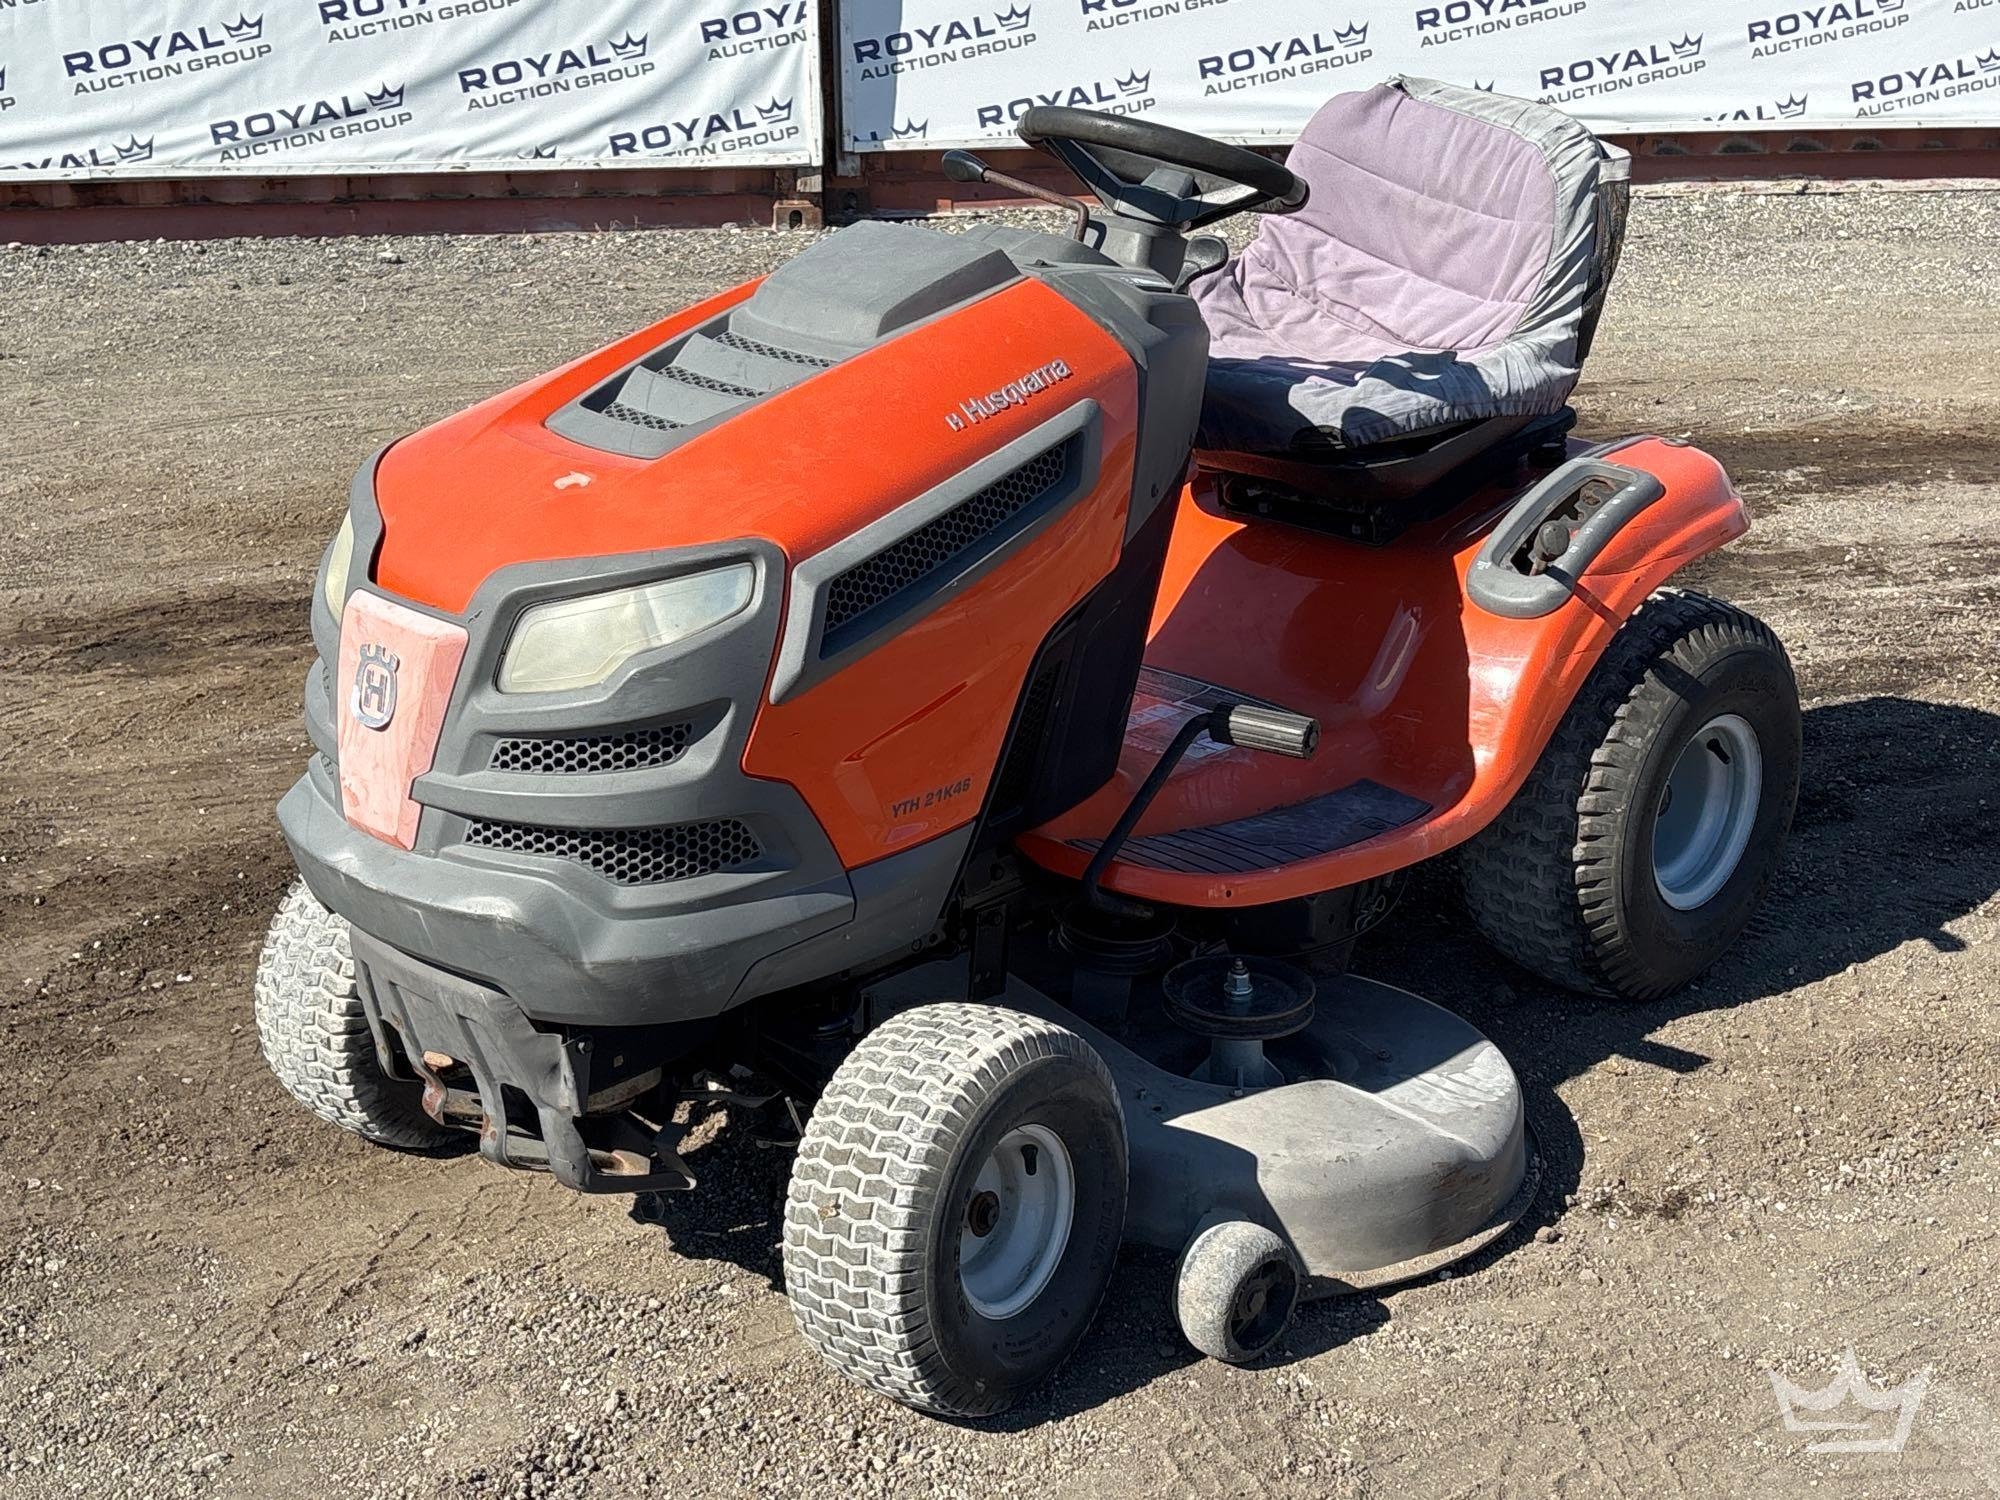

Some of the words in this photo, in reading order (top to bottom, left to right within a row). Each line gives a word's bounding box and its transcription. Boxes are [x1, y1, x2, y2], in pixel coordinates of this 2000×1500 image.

[328, 10, 433, 43] AUCTION
[1086, 3, 1180, 32] AUCTION
[1416, 0, 1549, 31] ROYA
[1420, 18, 1511, 48] AUCTION
[1515, 1, 1587, 27] GROUP
[1747, 0, 1874, 42] ROYAL
[1751, 30, 1837, 59] AUCTION
[1842, 14, 1909, 38] GROUP
[63, 27, 225, 77] ROYAL
[707, 29, 807, 61] AUCTION
[853, 16, 996, 63] ROYAL
[860, 50, 957, 81] AUCTION
[961, 33, 1037, 59] GROUP
[1198, 33, 1335, 80] ROYAL
[74, 62, 182, 96] AUCTION
[187, 44, 272, 73] GROUP
[458, 44, 611, 93] ROYAL
[467, 79, 570, 111] AUCTION
[575, 62, 656, 89] GROUP
[1203, 64, 1296, 97] AUCTION
[1301, 49, 1373, 75] GROUP
[1540, 44, 1670, 90] ROYAL
[1546, 76, 1633, 105] AUCTION
[1637, 60, 1706, 85] GROUP
[1851, 59, 1976, 103] ROYAL
[977, 82, 1116, 128] ROYAL
[1855, 89, 1940, 118] AUCTION
[1944, 75, 2000, 98] GROU
[210, 95, 367, 145] ROYAL
[220, 130, 325, 163] AUCTION
[331, 112, 413, 141] GROUP
[609, 109, 757, 157] ROYAL
[722, 126, 800, 152] GROUP
[959, 359, 1073, 424] Husqvarna
[892, 797, 920, 818] YTH
